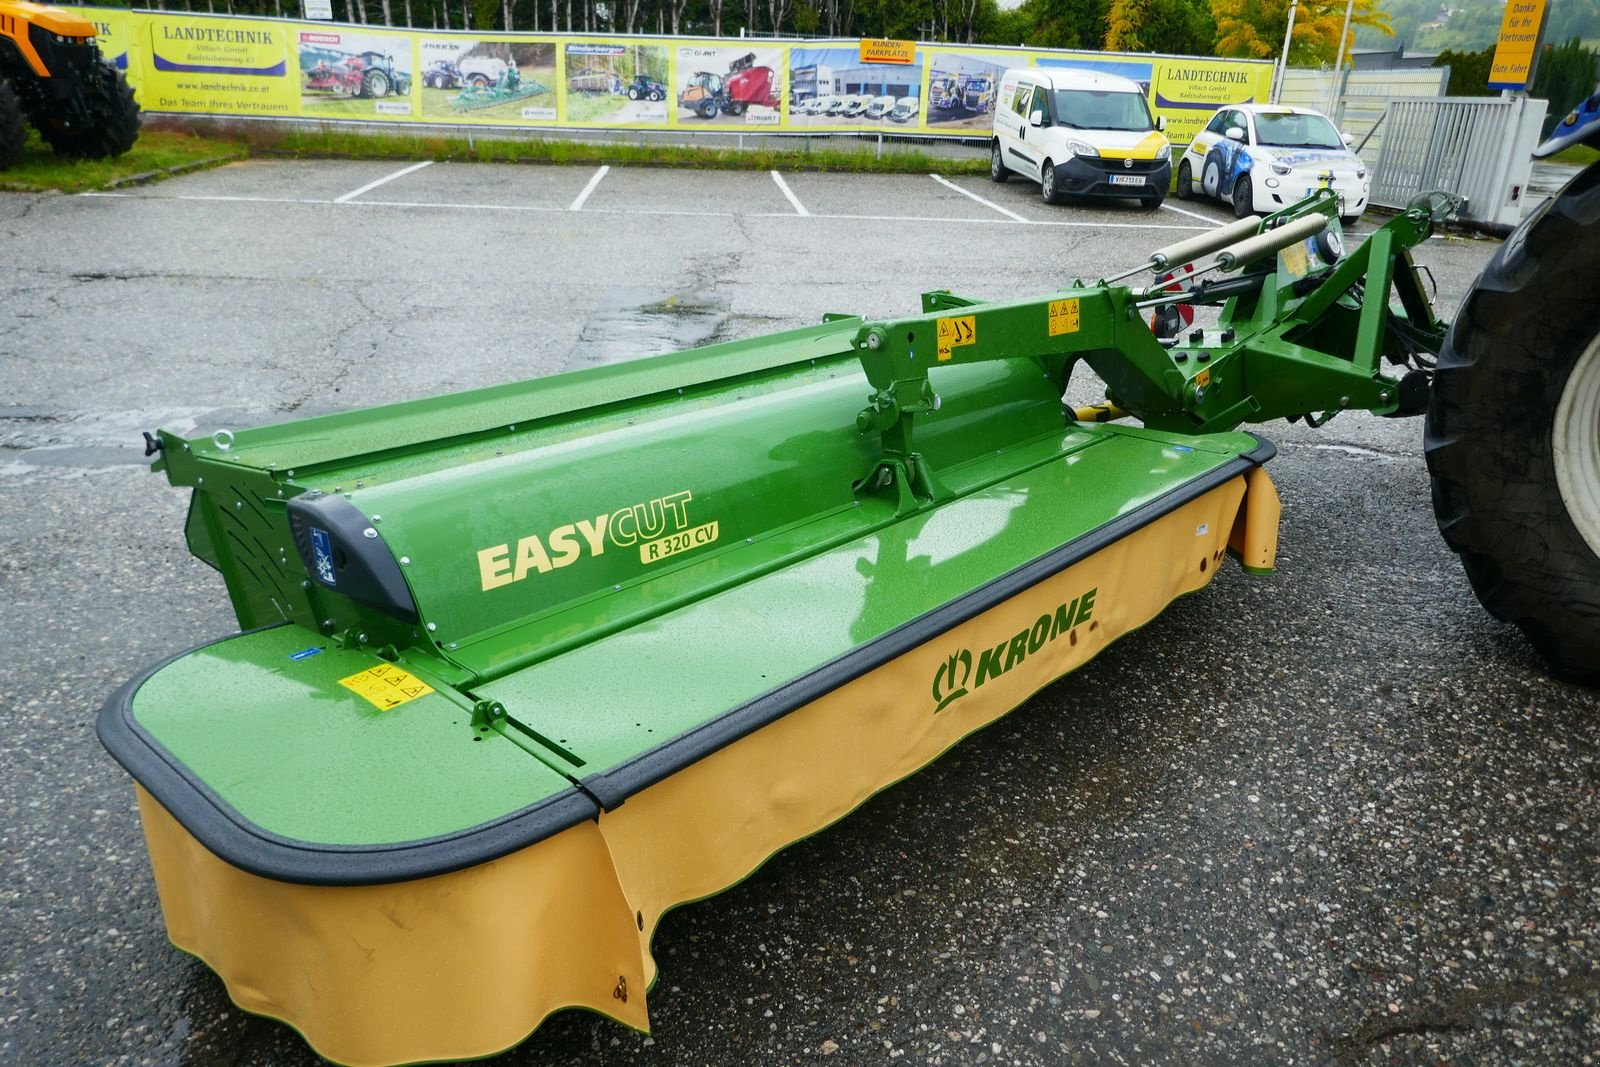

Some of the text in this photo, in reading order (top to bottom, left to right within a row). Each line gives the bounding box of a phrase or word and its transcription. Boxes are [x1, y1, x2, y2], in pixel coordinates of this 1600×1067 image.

[1512, 3, 1537, 13] Danke
[163, 26, 273, 45] LANDTECHNIK
[1500, 32, 1536, 42] Vertrauen
[1167, 68, 1249, 84] LANDTECHNIK
[177, 81, 270, 93] www.landtechnik.co.at
[159, 97, 289, 112] Das Team Ihres Vertrauens
[648, 524, 714, 560] R 320 CV
[974, 586, 1098, 690] KRONE
